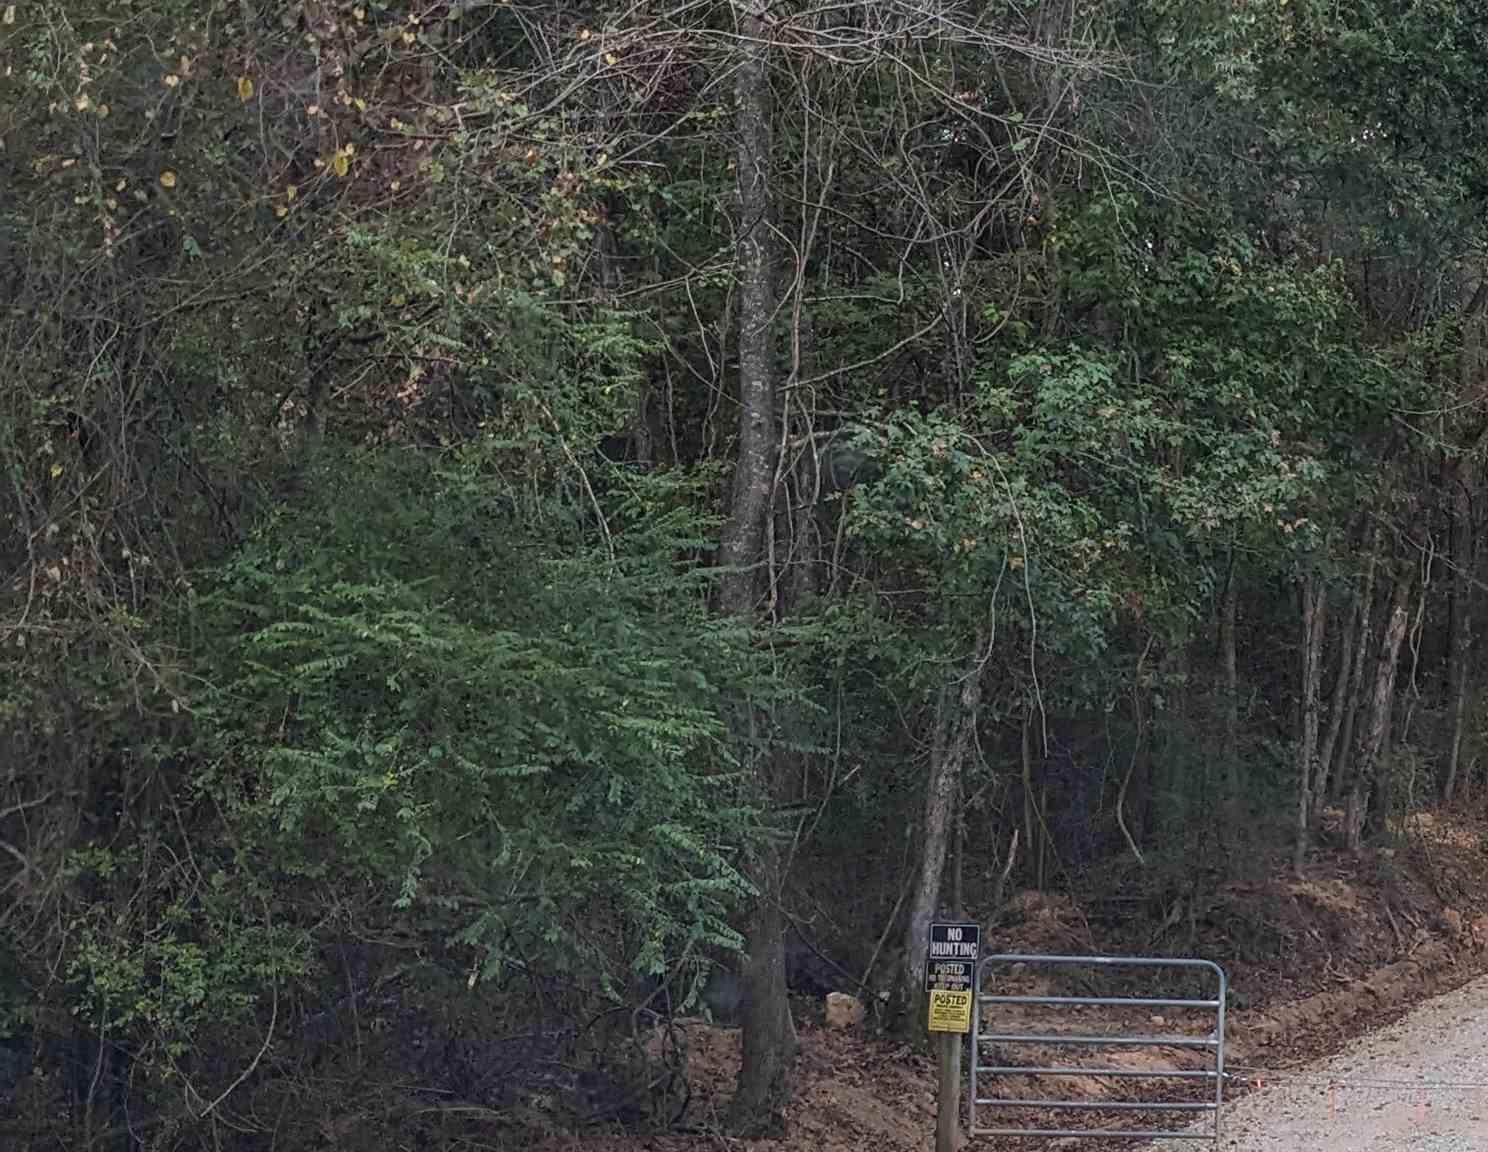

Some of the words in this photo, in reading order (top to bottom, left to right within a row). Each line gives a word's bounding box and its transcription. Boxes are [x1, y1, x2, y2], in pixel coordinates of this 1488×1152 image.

[947, 928, 962, 940] NO
[932, 942, 977, 956] HUNTING
[935, 964, 965, 974] POSTED
[934, 994, 967, 1005] POSTED
